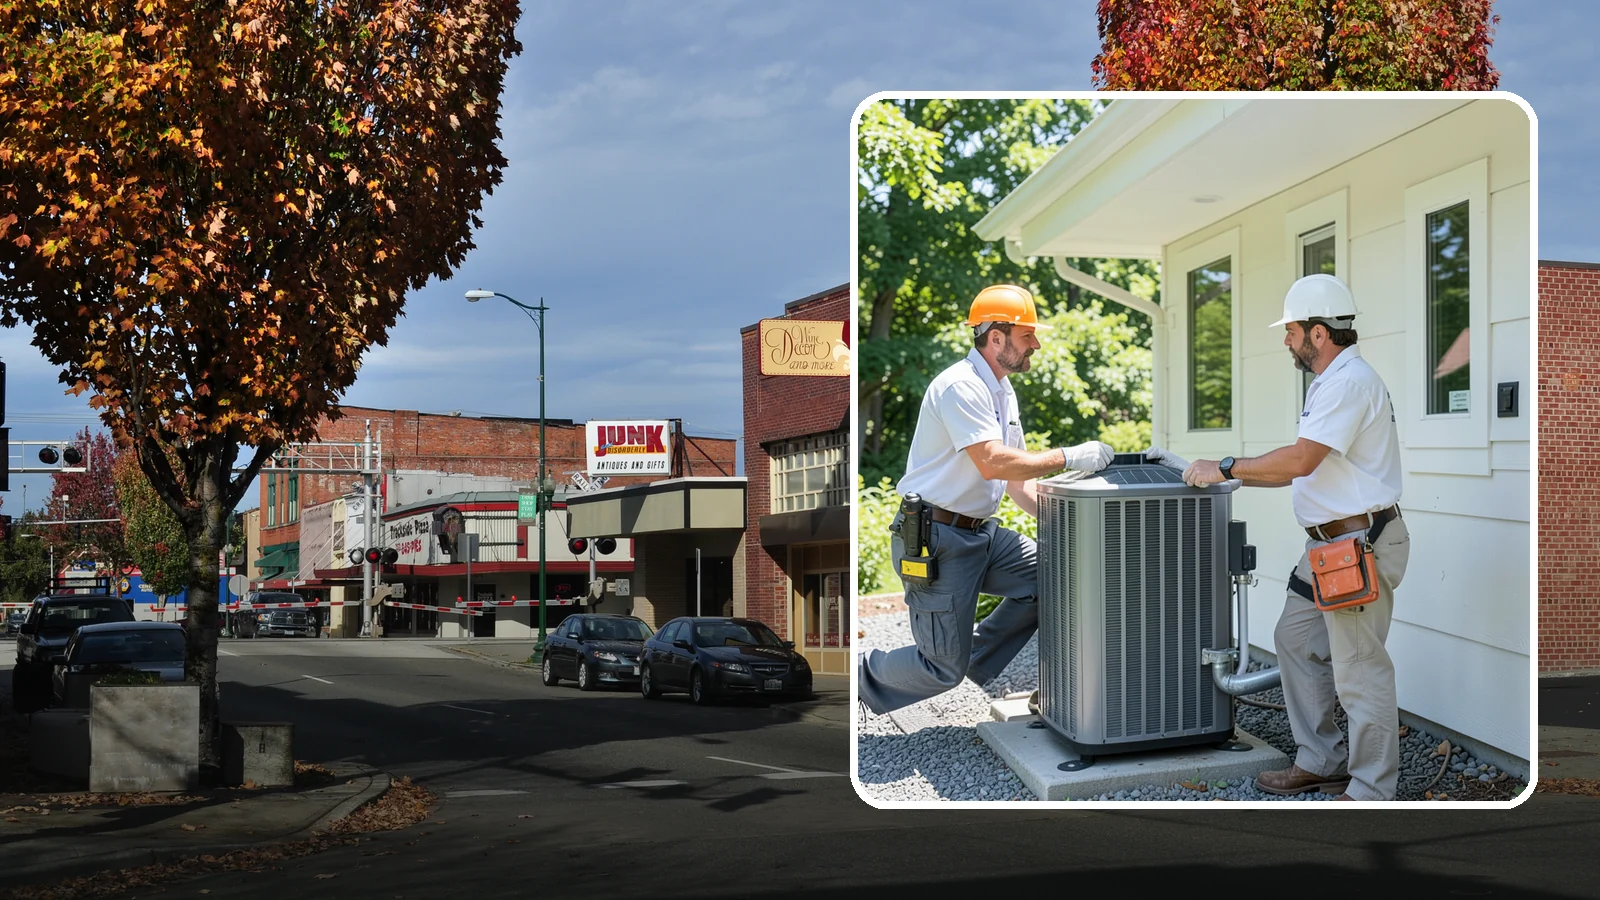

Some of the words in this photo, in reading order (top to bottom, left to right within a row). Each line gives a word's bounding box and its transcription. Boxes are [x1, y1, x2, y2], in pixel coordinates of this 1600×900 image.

[765, 327, 831, 365] Decor
[595, 425, 665, 457] JUNK
[597, 461, 628, 470] ANTIQUES
[631, 461, 644, 470] AND
[647, 461, 666, 470] GIFTS
[390, 522, 413, 540] Trackside
[414, 519, 429, 535] Pizza
